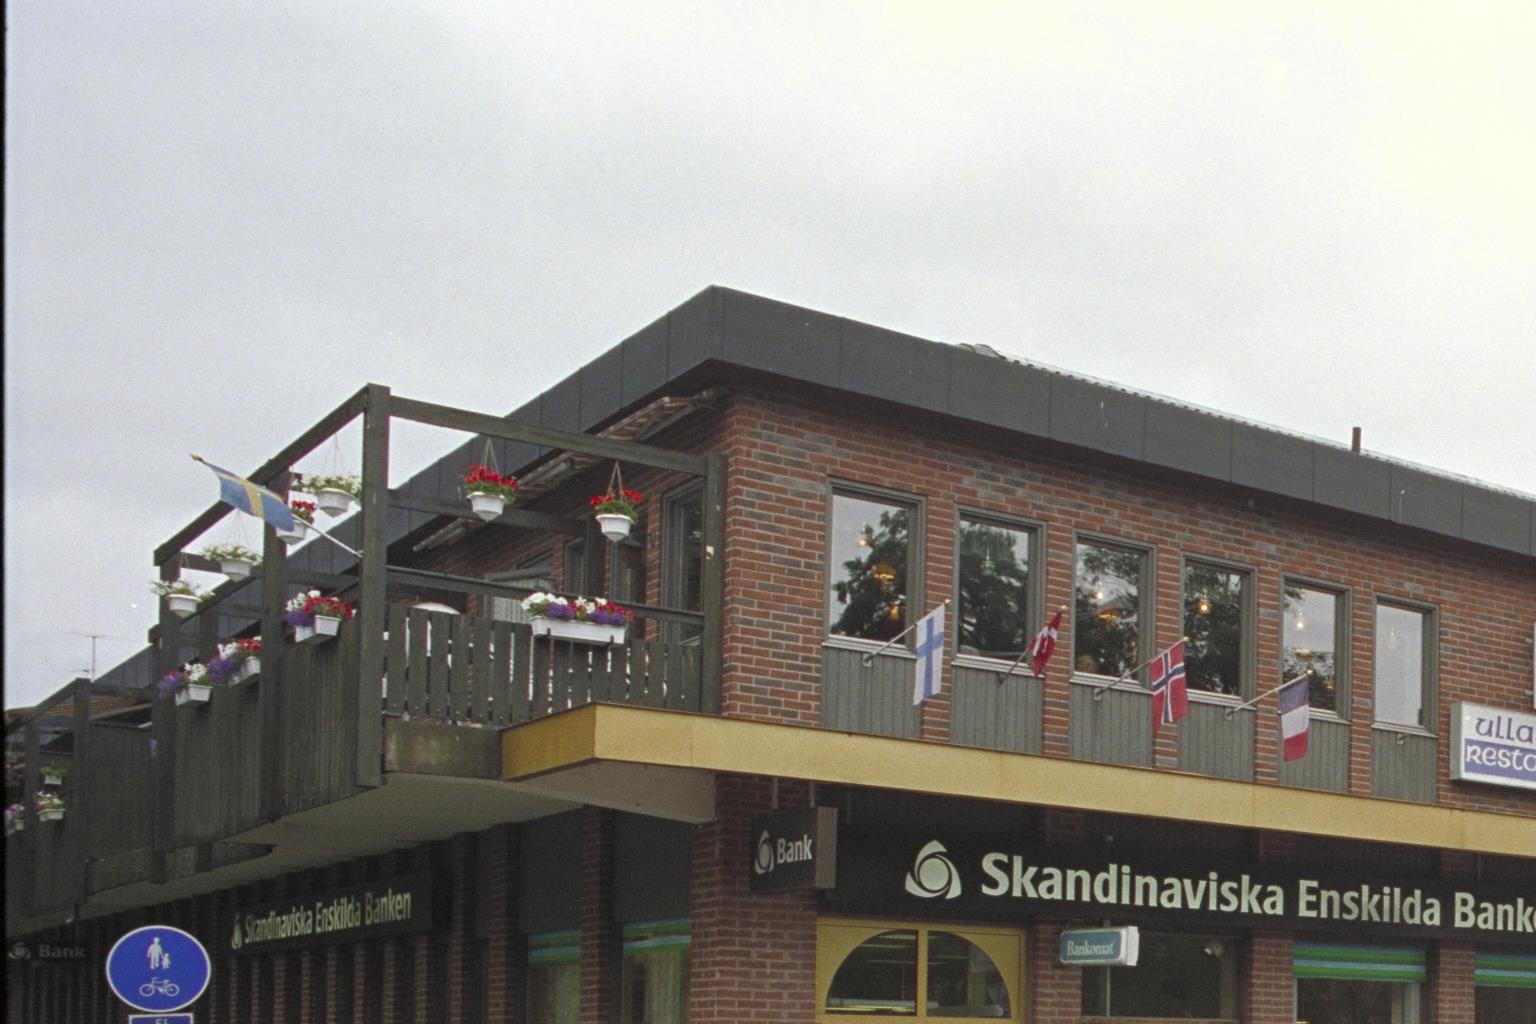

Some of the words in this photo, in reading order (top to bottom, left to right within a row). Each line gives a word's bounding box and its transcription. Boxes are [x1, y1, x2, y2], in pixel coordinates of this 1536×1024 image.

[777, 834, 813, 864] Bank
[980, 852, 1284, 916] Skandinaviska
[1298, 879, 1441, 927] Enskilda
[245, 905, 313, 943] Skandinaviska
[315, 896, 361, 933] Enskilda
[365, 888, 411, 926] Banken
[39, 944, 86, 958] Bank
[1066, 939, 1116, 957] Bankomat
